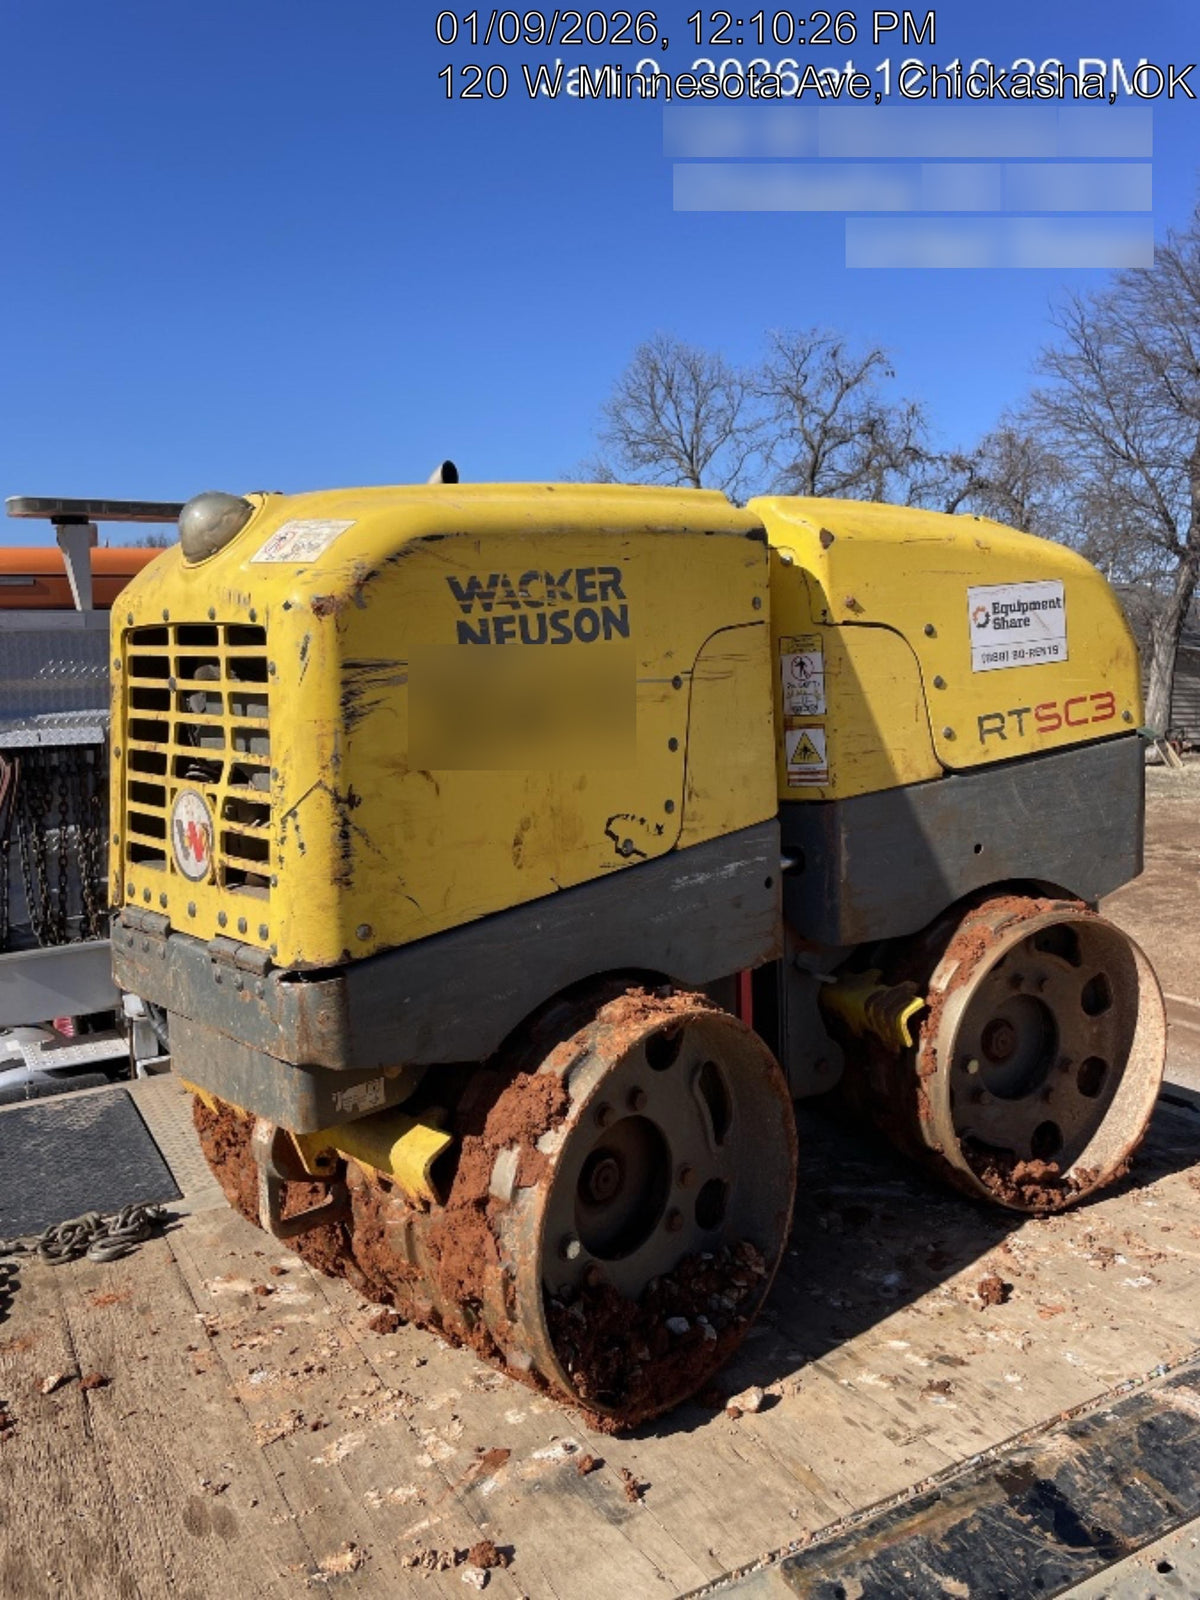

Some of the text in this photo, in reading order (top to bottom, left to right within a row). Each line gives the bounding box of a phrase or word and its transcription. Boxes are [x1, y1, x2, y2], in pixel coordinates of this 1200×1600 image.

[446, 566, 627, 614] WACKER
[992, 597, 1062, 616] Equipment
[993, 617, 1031, 630] Share
